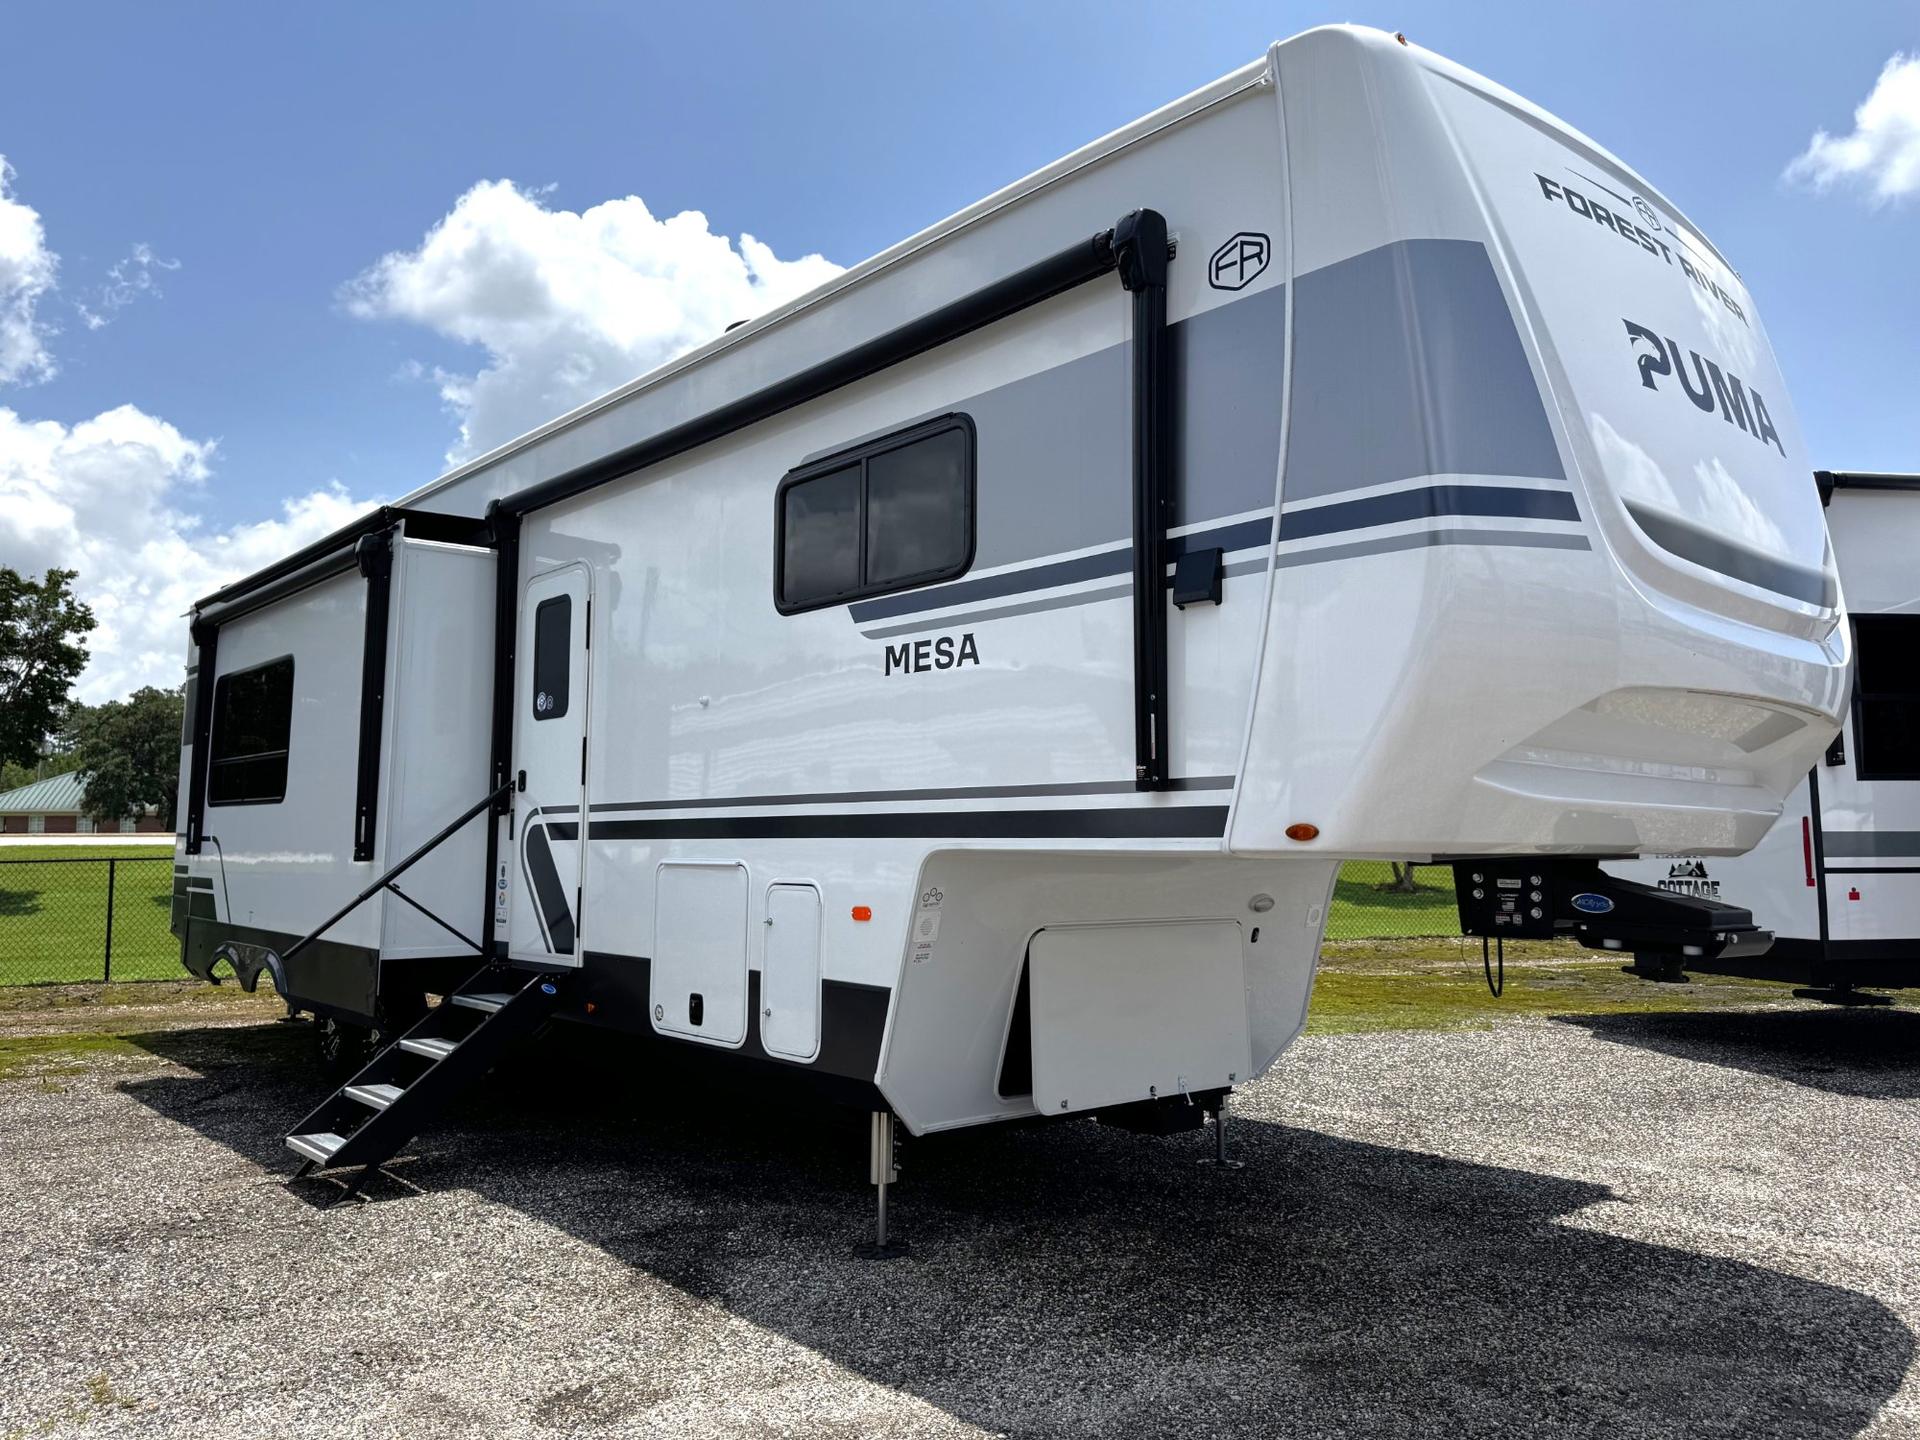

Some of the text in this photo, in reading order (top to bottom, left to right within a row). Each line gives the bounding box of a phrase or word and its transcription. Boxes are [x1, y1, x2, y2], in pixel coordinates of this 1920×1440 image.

[1533, 172, 1750, 328] FOREST RIVER
[1622, 318, 1787, 459] PUMA
[885, 633, 980, 676] MESA
